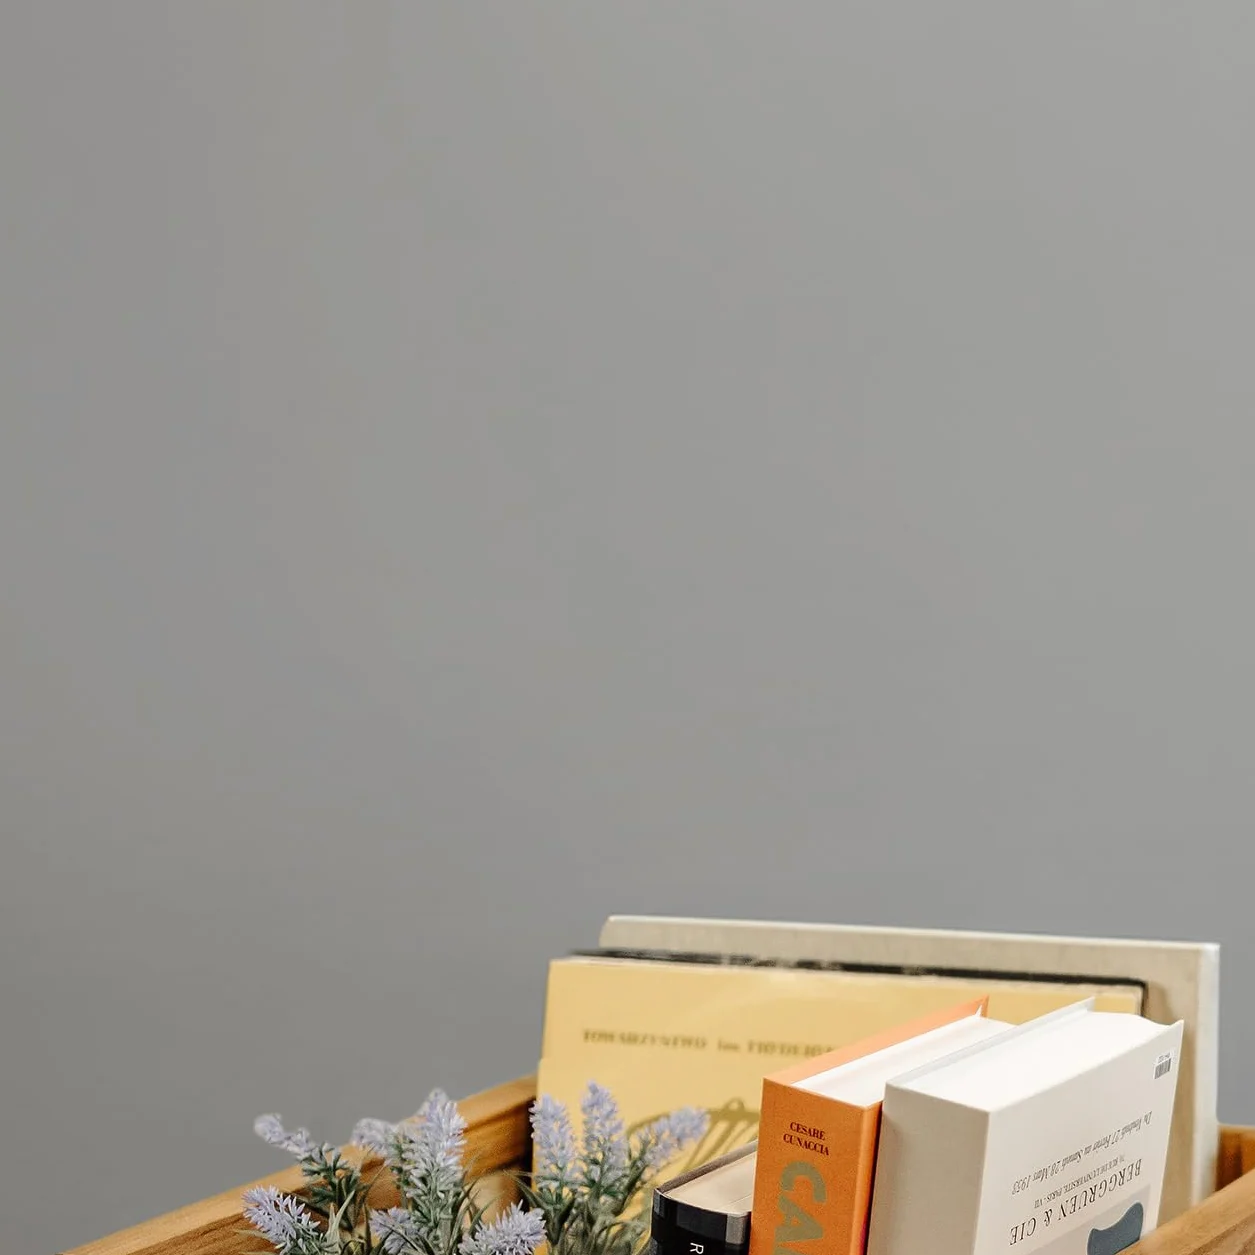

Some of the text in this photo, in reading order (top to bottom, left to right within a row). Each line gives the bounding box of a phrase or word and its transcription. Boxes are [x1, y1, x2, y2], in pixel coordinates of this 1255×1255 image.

[789, 1121, 826, 1141] CESARE
[783, 1133, 830, 1156] CUNACCIA
[1050, 1160, 1061, 1177] 28
[1011, 1174, 1031, 1195] 1953
[1009, 1158, 1142, 1246] BERGGRUEN & CIE
